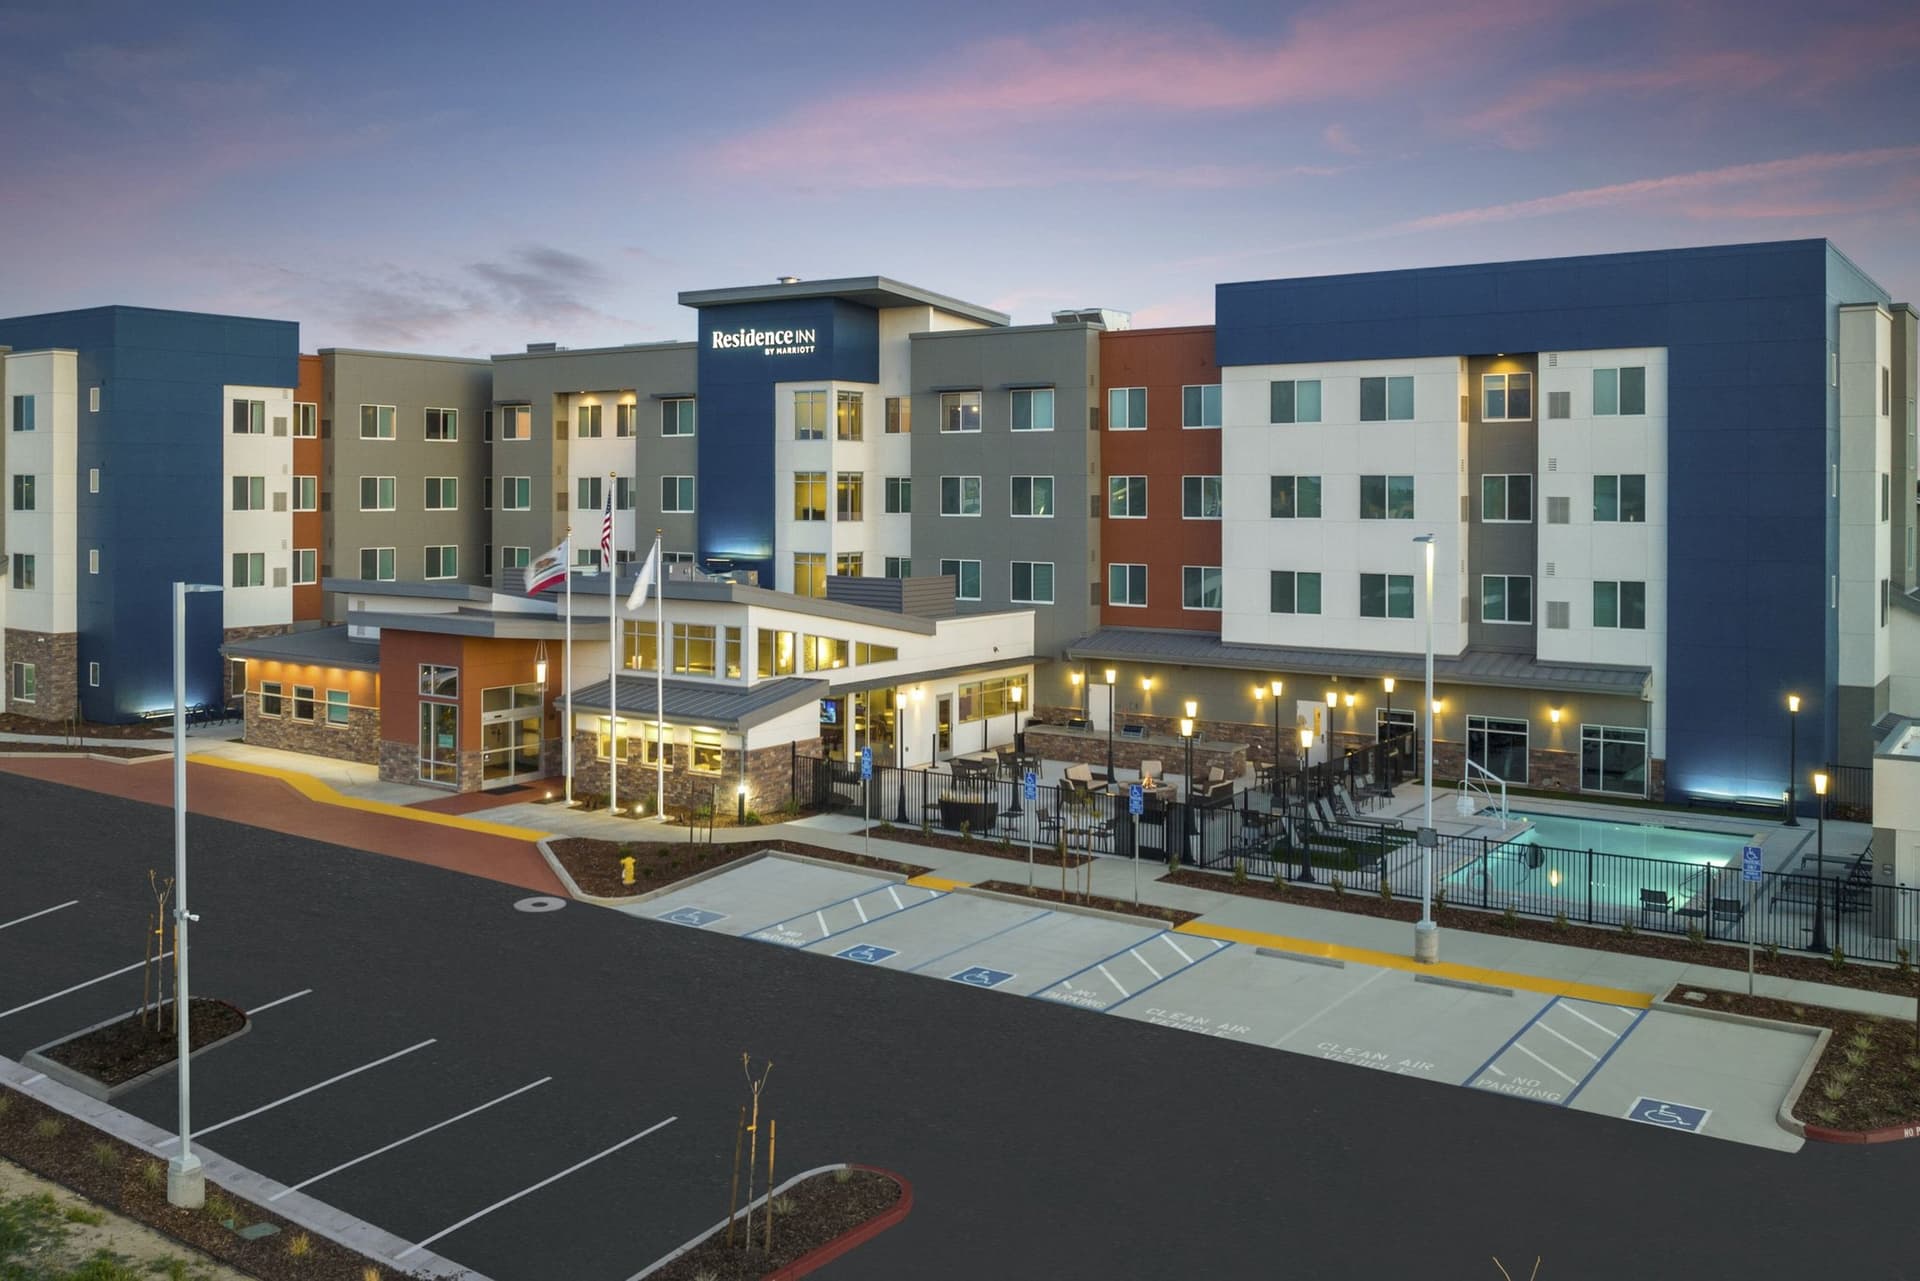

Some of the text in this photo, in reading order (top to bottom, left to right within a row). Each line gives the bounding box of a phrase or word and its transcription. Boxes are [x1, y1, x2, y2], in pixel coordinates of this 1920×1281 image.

[712, 328, 816, 348] Residence INN
[764, 346, 815, 356] BY MARRIOTT
[1145, 1007, 1252, 1035] CLEAN AIR
[1316, 1042, 1436, 1072] CLEAN AIR
[1475, 1079, 1561, 1100] PARKING
[1511, 1076, 1541, 1088] NO
[1904, 1127, 1914, 1137] NO
